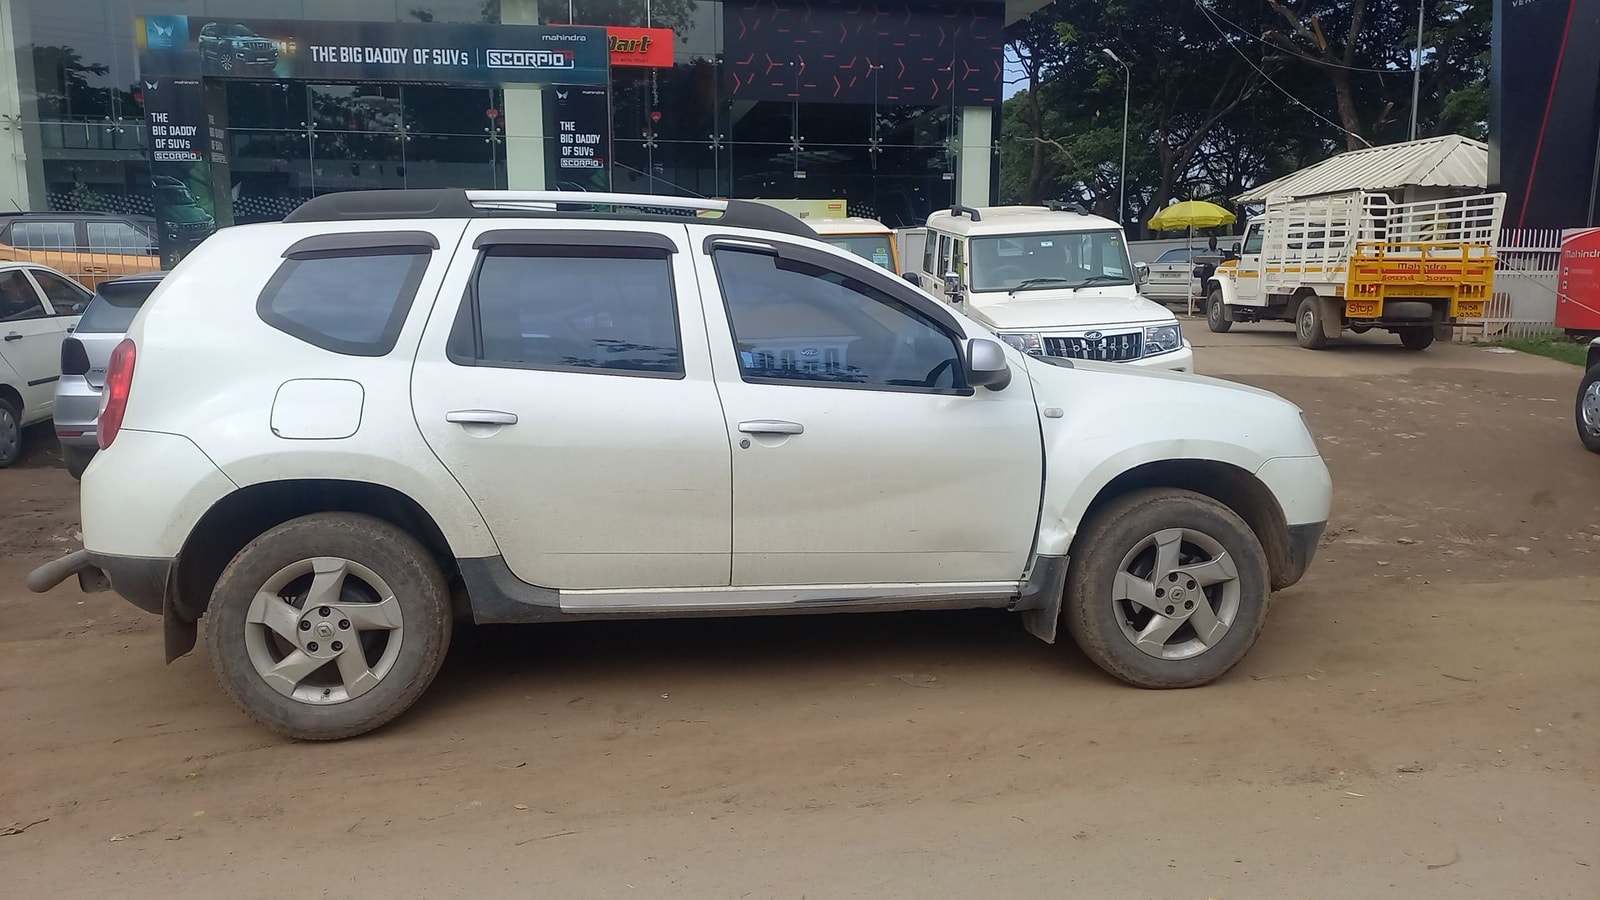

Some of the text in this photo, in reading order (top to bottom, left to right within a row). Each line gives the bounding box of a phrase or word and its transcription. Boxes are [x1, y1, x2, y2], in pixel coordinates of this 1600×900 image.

[310, 46, 565, 68] THE BIG DADDY OF SUVs SCORPIO
[151, 113, 169, 123] THE
[152, 126, 197, 136] BIG DADDY
[560, 121, 576, 131] THE
[560, 133, 601, 144] BIG DADDY
[155, 139, 191, 149] OF SUVs
[155, 152, 197, 160] SCORPIO
[562, 146, 594, 156] OF SUVs
[562, 159, 599, 167] SCORPIO
[1397, 262, 1447, 270] Mahndra
[1349, 303, 1374, 316] Stop
